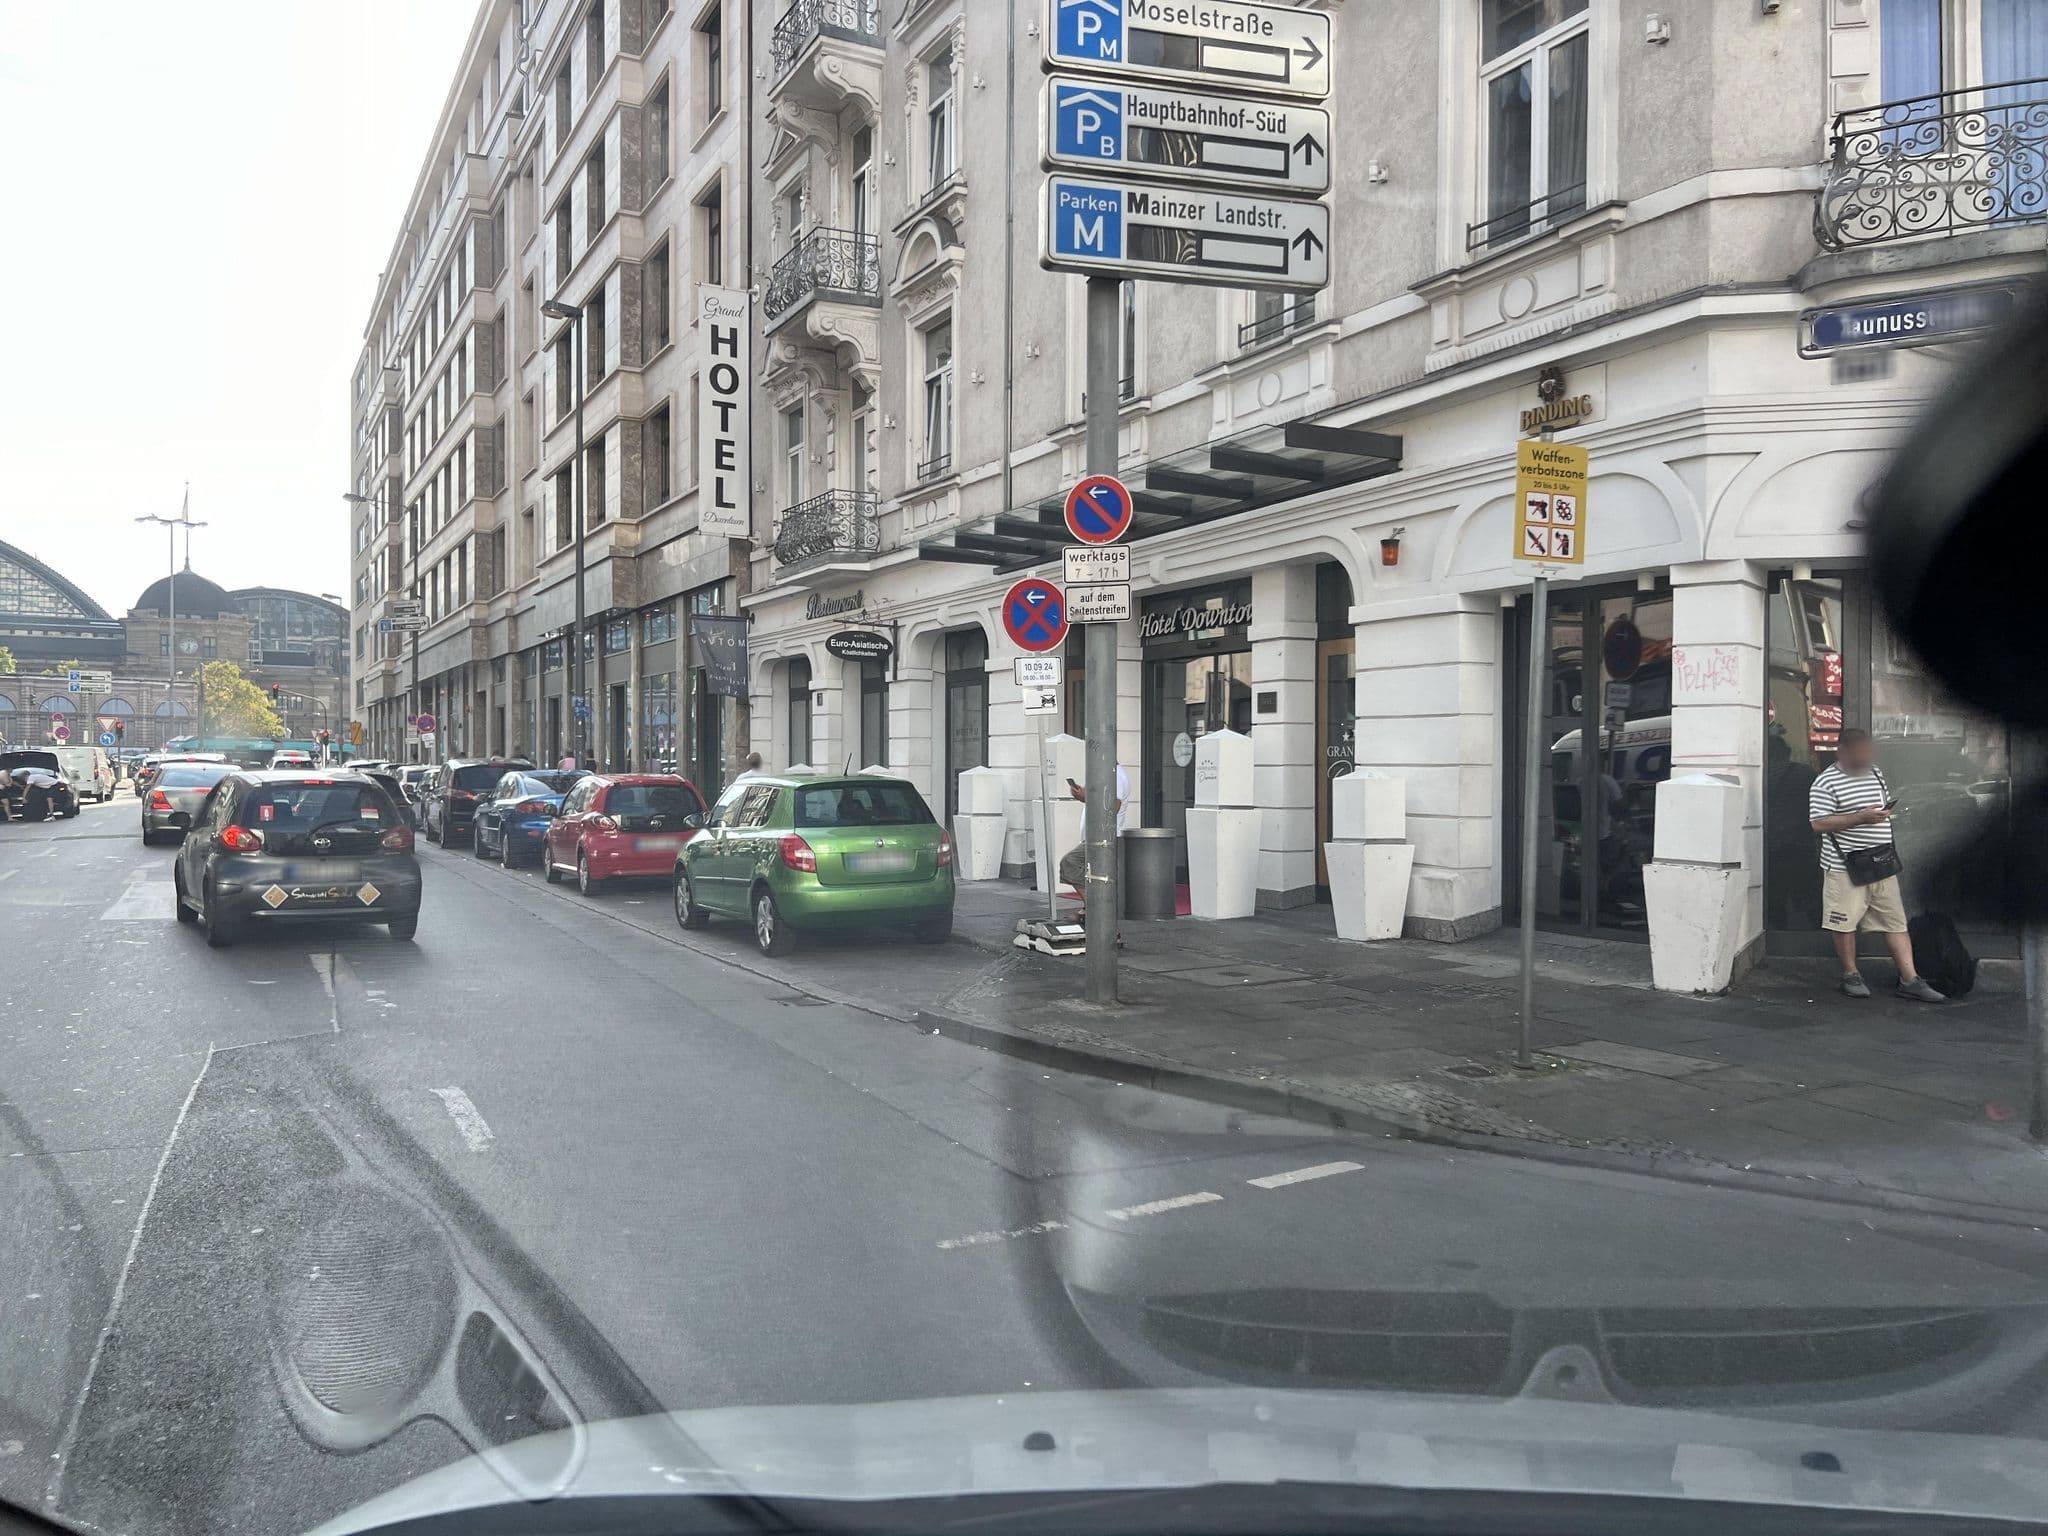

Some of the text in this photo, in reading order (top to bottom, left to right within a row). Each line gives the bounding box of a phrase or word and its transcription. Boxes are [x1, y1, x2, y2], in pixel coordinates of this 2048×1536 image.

[1127, 0, 1274, 36] Moselstraße
[1077, 11, 1117, 60] P M
[1127, 94, 1287, 134] Hauptbahnhof-Süd
[1076, 109, 1115, 157] P B
[1059, 192, 1118, 212] Parken
[1127, 192, 1287, 230] Mainzer Landstr.
[1073, 213, 1104, 252] M
[702, 296, 744, 319] Grand
[709, 324, 740, 509] HOTEL
[1519, 394, 1593, 432] BINDING
[1531, 449, 1575, 465] Waffen-
[1520, 463, 1585, 480] verbotszone
[1069, 551, 1126, 564] werktags
[1075, 568, 1081, 578] 7
[1098, 567, 1109, 578] 17
[1112, 566, 1119, 578] h
[1080, 592, 1115, 603] auf dem
[1069, 604, 1126, 616] Seitenstreifen
[1138, 602, 1252, 638] Hotel Downto
[830, 638, 889, 650] Euro-Asiatische
[1327, 745, 1354, 758] GRAN
